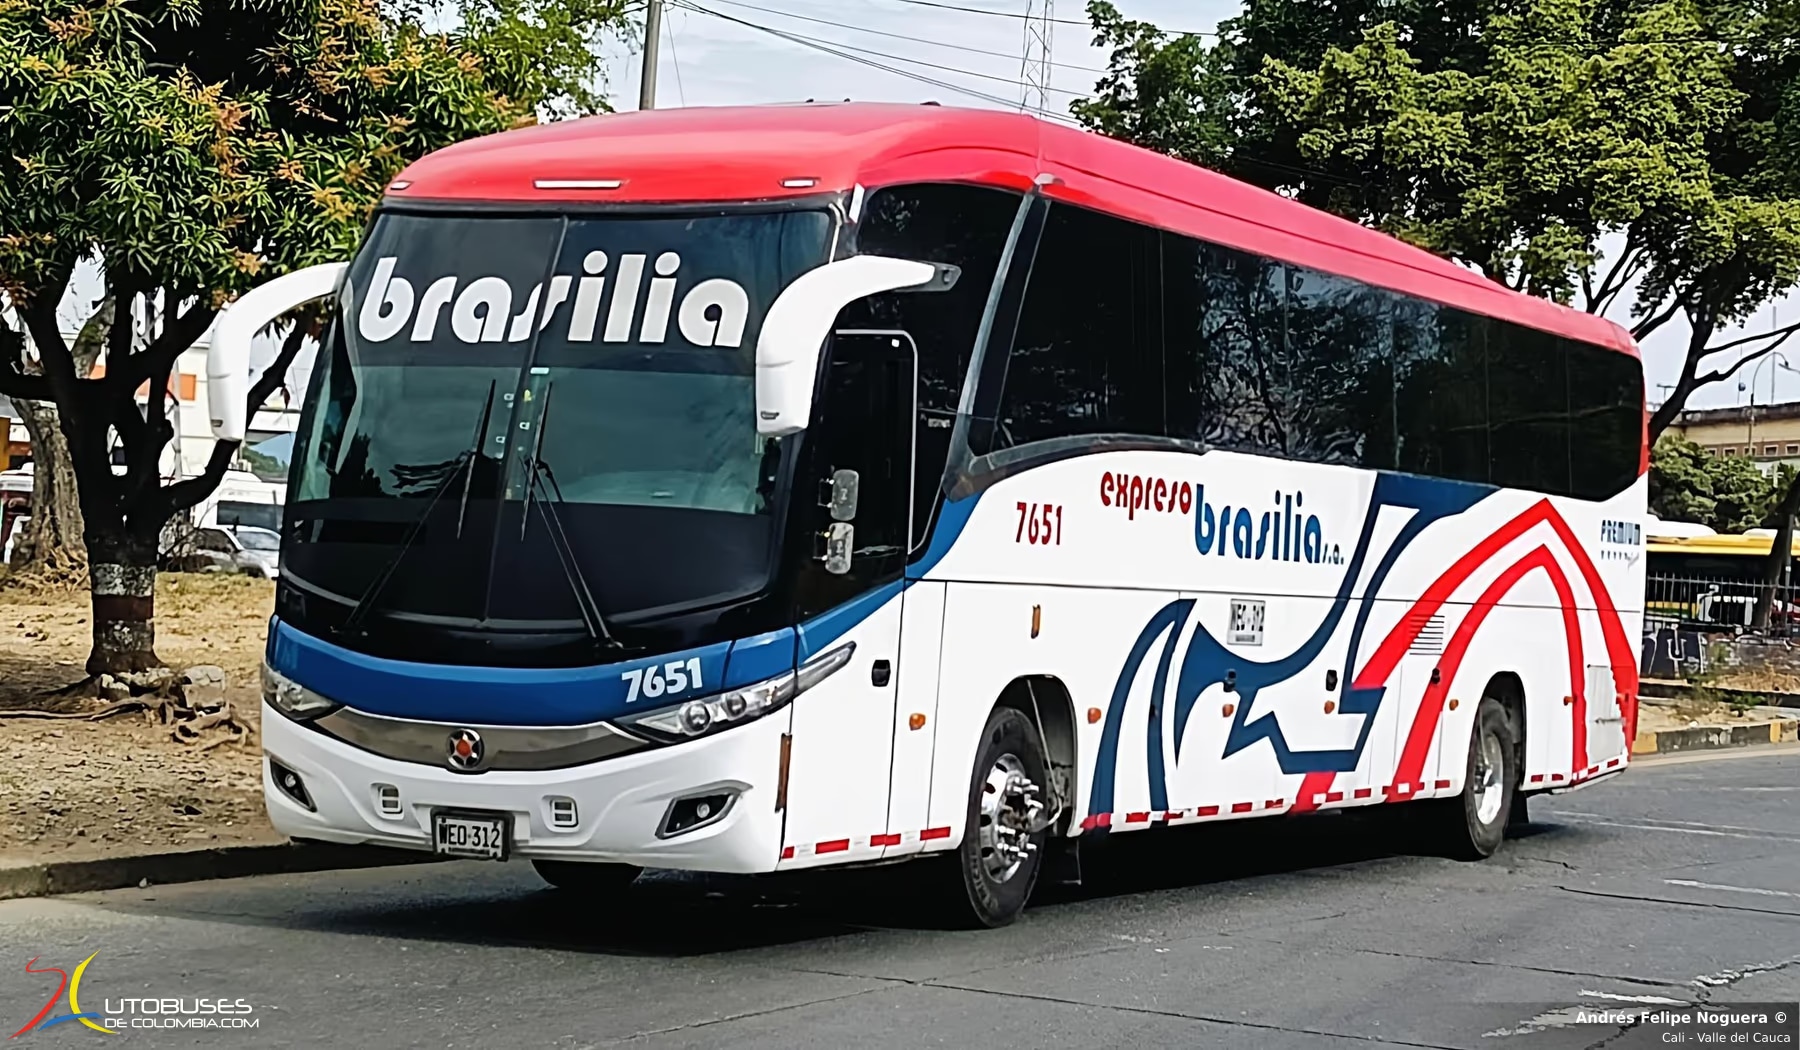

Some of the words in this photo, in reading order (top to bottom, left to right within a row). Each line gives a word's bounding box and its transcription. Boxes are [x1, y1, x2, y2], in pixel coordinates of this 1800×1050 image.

[359, 250, 749, 348] brasilia
[1016, 501, 1062, 545] 7651
[1100, 471, 1192, 520] expreso
[1194, 483, 1321, 564] brasilia
[621, 657, 702, 702] 7651
